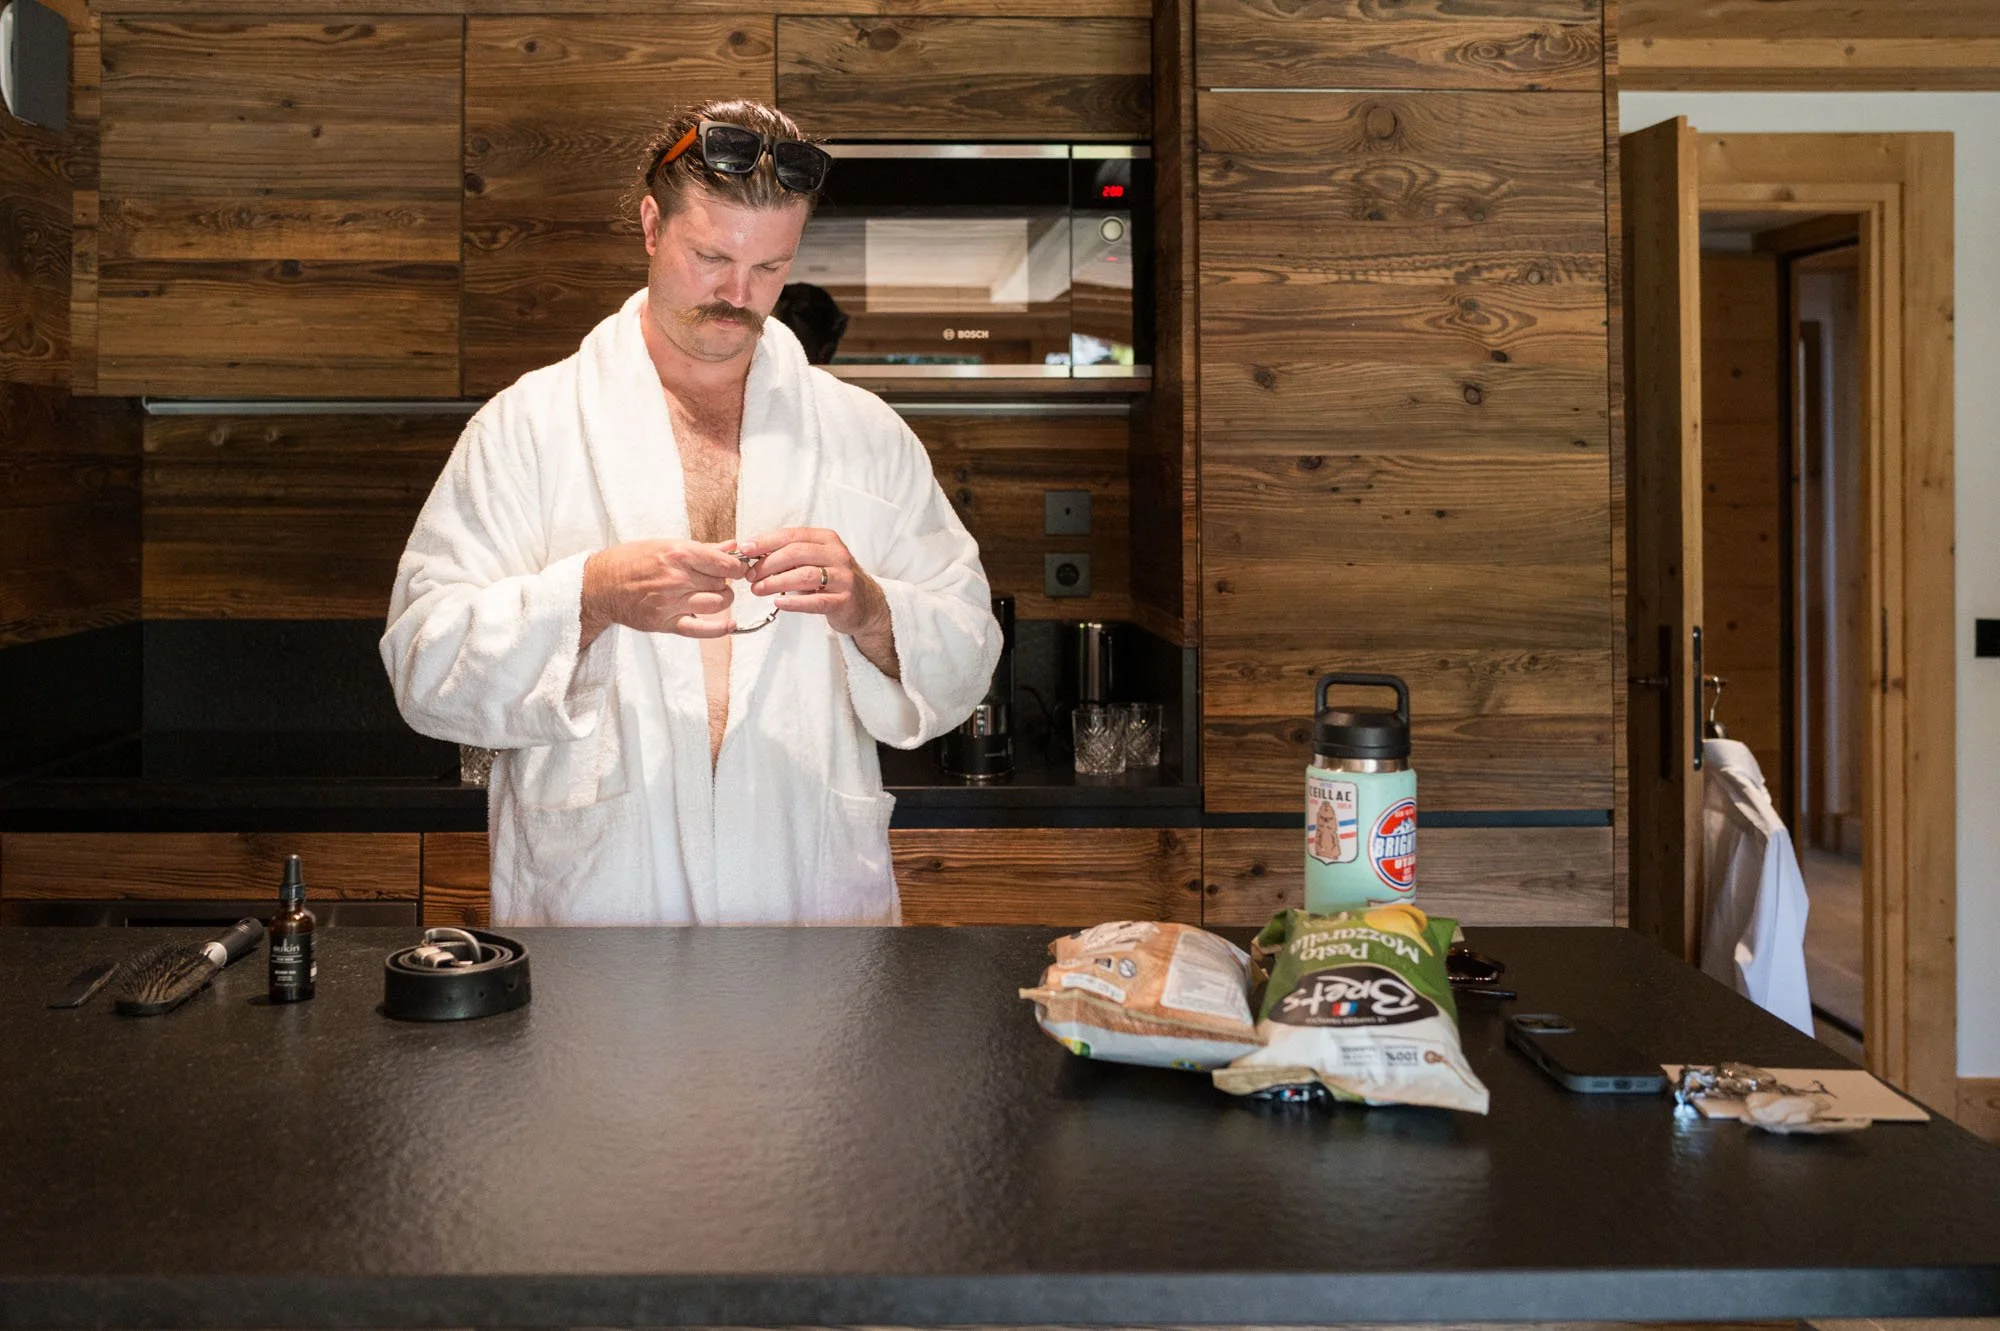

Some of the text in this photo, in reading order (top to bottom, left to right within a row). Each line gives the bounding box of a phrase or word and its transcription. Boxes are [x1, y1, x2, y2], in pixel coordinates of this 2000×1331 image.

[957, 330, 989, 339] BOSCH
[1309, 785, 1352, 802] CEILLAC
[1290, 927, 1420, 964] Mozzarella
[1300, 942, 1369, 960] Pesto
[1282, 975, 1420, 1016] Brets
